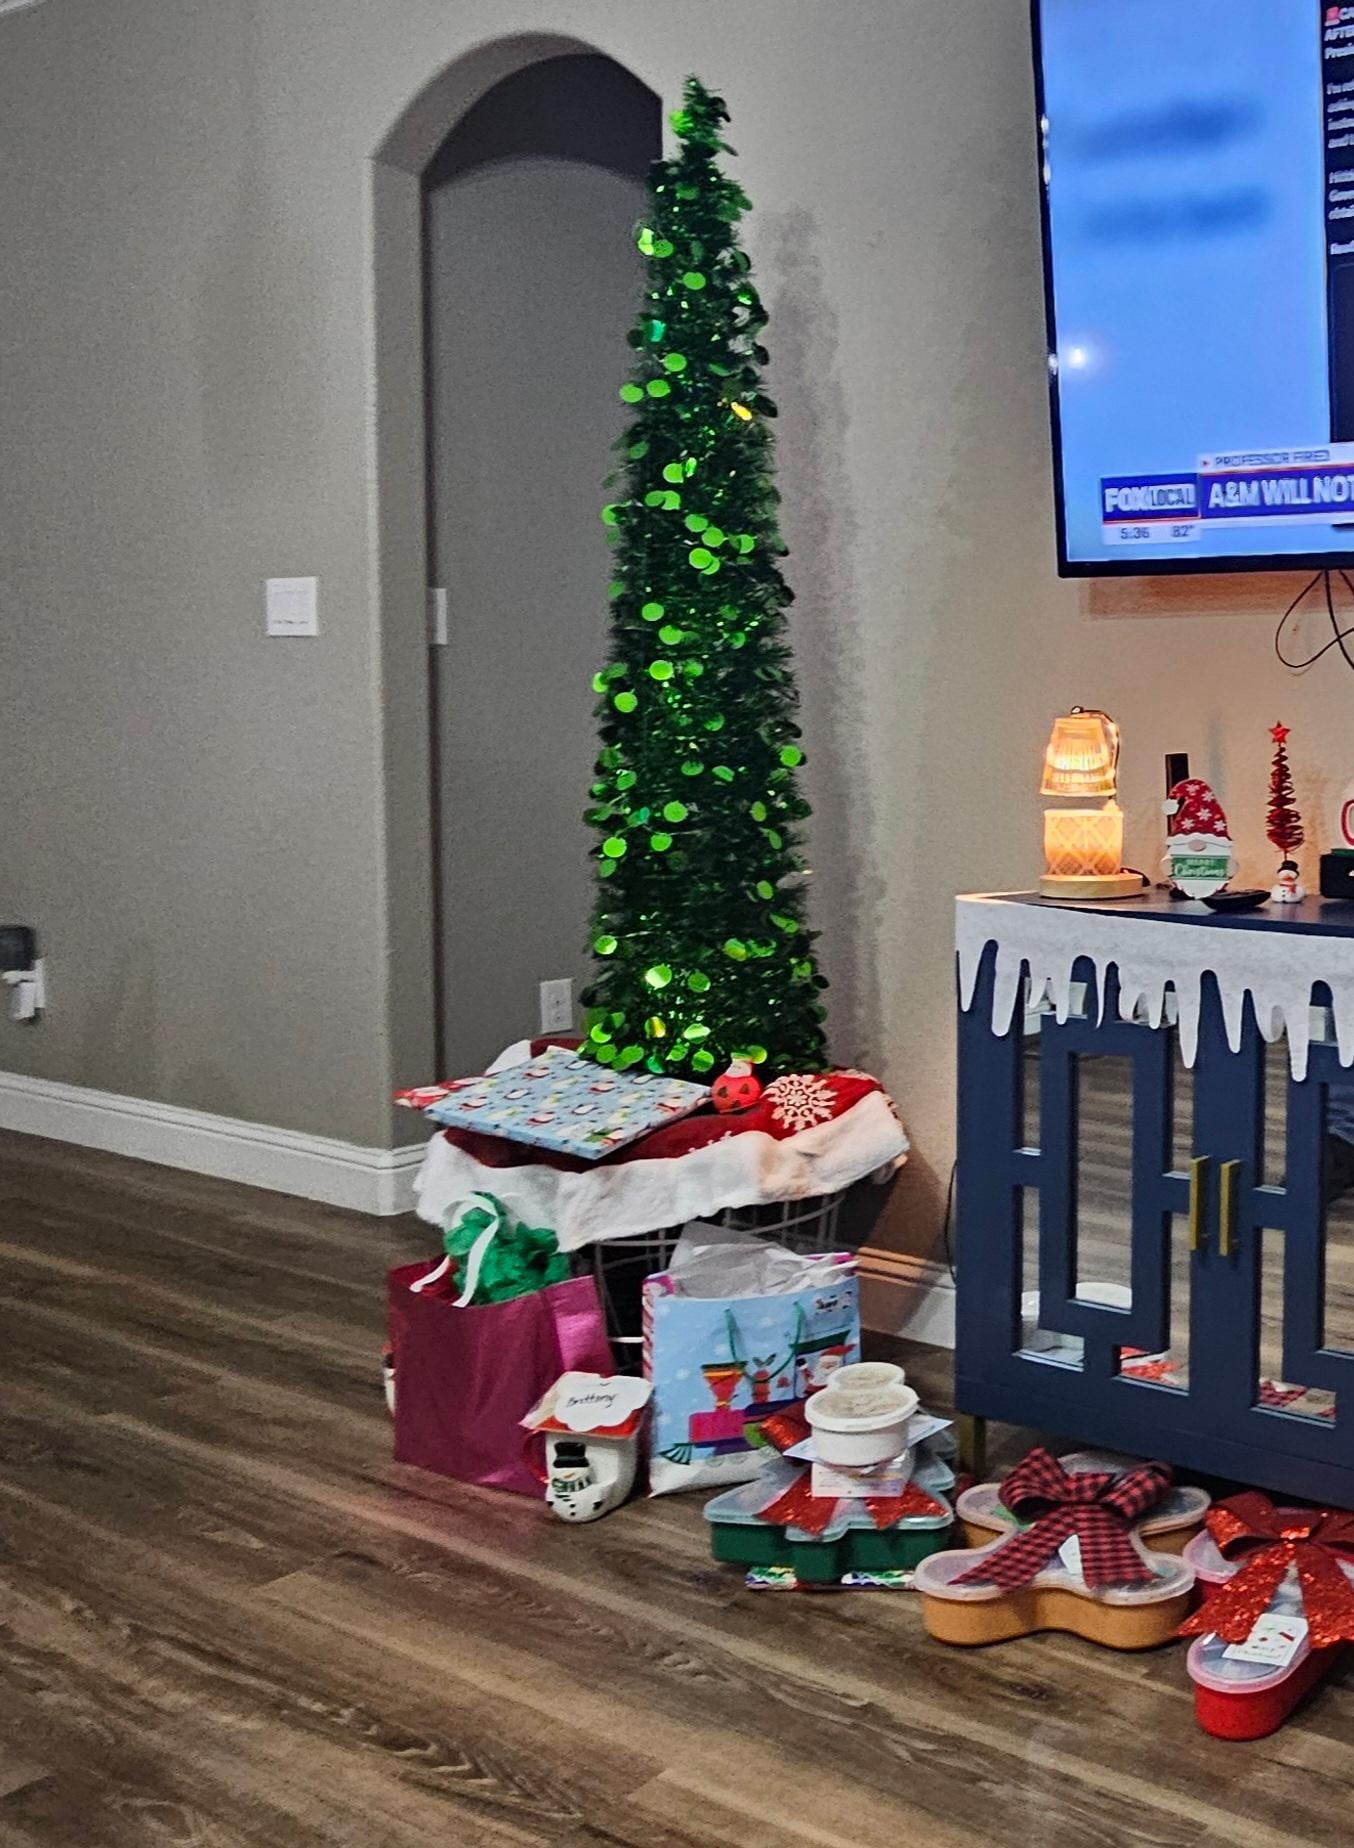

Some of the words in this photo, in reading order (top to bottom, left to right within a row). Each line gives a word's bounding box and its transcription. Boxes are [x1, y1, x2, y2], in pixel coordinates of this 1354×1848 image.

[1104, 485, 1149, 513] FOX
[1150, 484, 1196, 509] LOCAL
[1208, 479, 1260, 510] A&M
[1261, 476, 1311, 506] WILL
